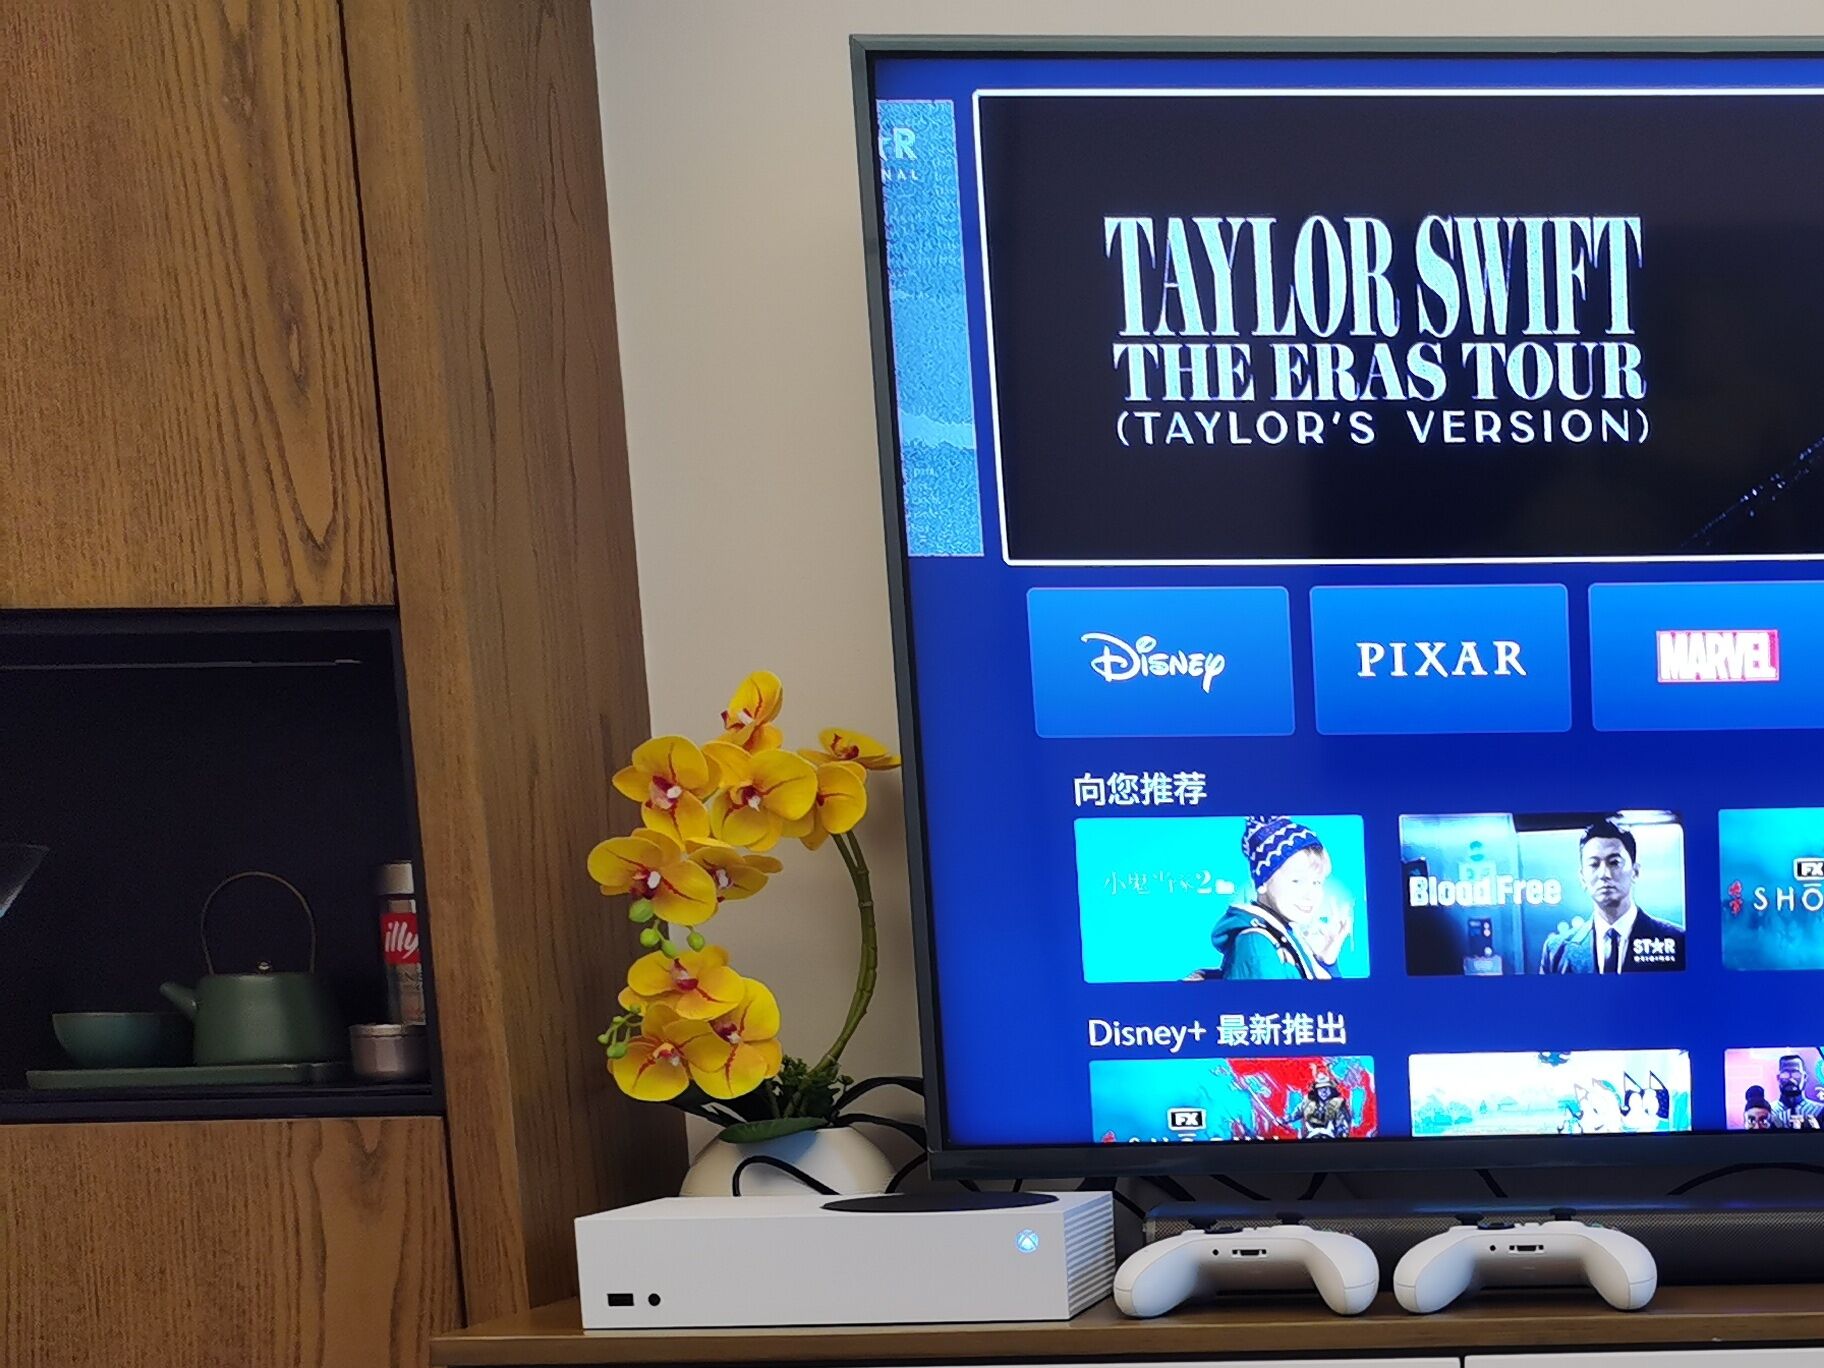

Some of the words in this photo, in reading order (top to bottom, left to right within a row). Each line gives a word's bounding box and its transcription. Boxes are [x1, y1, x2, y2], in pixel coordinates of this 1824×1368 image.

[1104, 215, 1400, 337] TAYLOR
[1416, 214, 1643, 337] SWIFT
[1113, 342, 1255, 402] THE
[1270, 342, 1446, 401] ERAS
[1462, 341, 1647, 401] TOUR
[1115, 409, 1376, 447] (TAYLOR'S
[1407, 407, 1652, 446] VERSION)
[1081, 633, 1226, 693] Disney
[1355, 639, 1527, 678] PIXAR
[1656, 629, 1780, 683] MARVEL
[1073, 771, 1208, 807] 向您推荐
[1408, 874, 1494, 907] Blood
[1496, 873, 1562, 906] Free
[384, 920, 419, 960] illy
[1087, 1017, 1207, 1054] Disney+
[1215, 1011, 1348, 1047] 最新推出
[1174, 1112, 1201, 1127] FX
